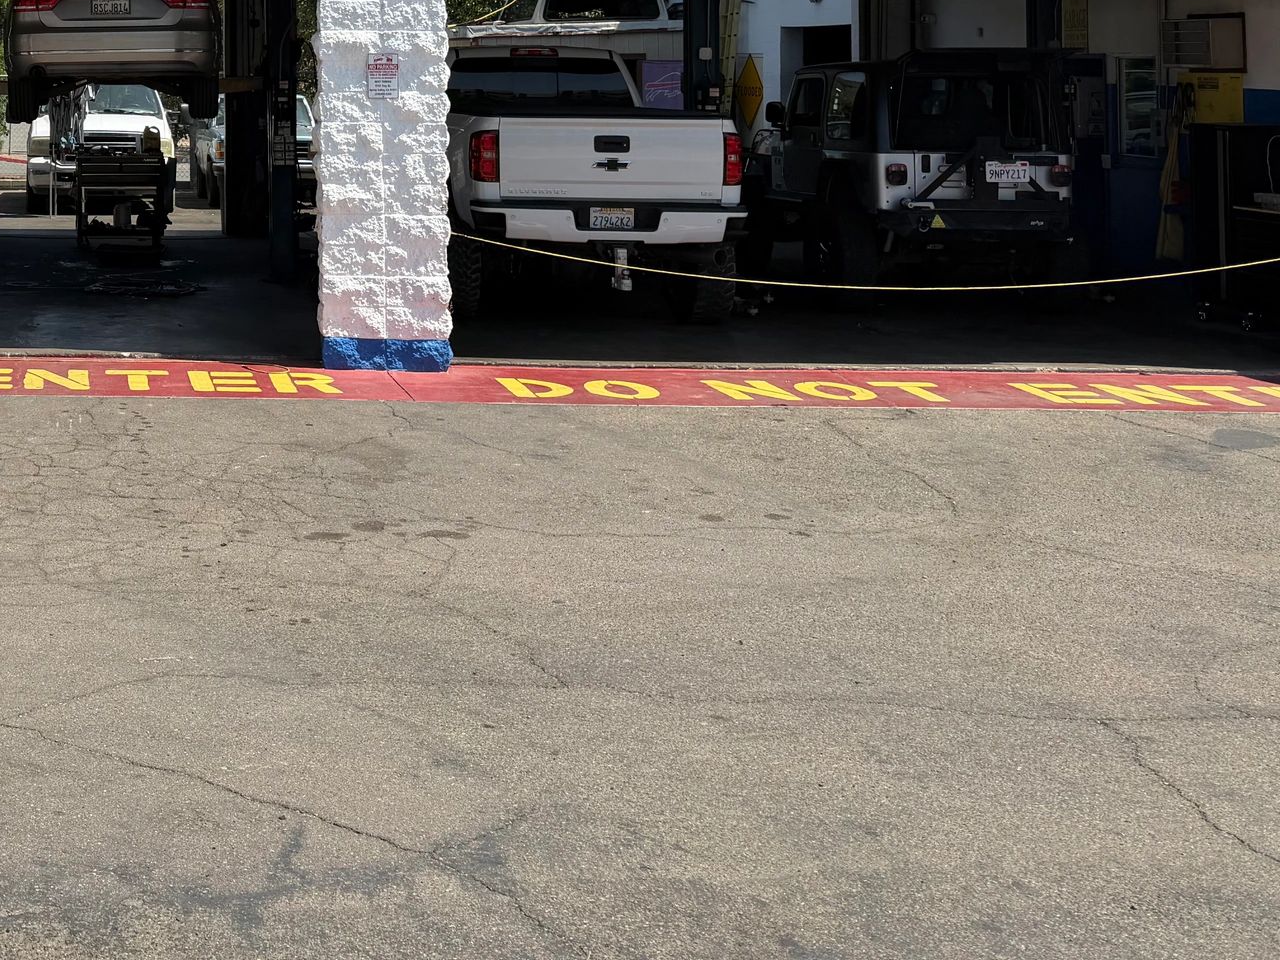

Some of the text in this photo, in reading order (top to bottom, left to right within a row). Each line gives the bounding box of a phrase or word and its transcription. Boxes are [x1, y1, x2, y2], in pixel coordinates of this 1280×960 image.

[989, 169, 1027, 180] 9NPY217
[497, 378, 661, 401] DO
[699, 379, 951, 403] NOT
